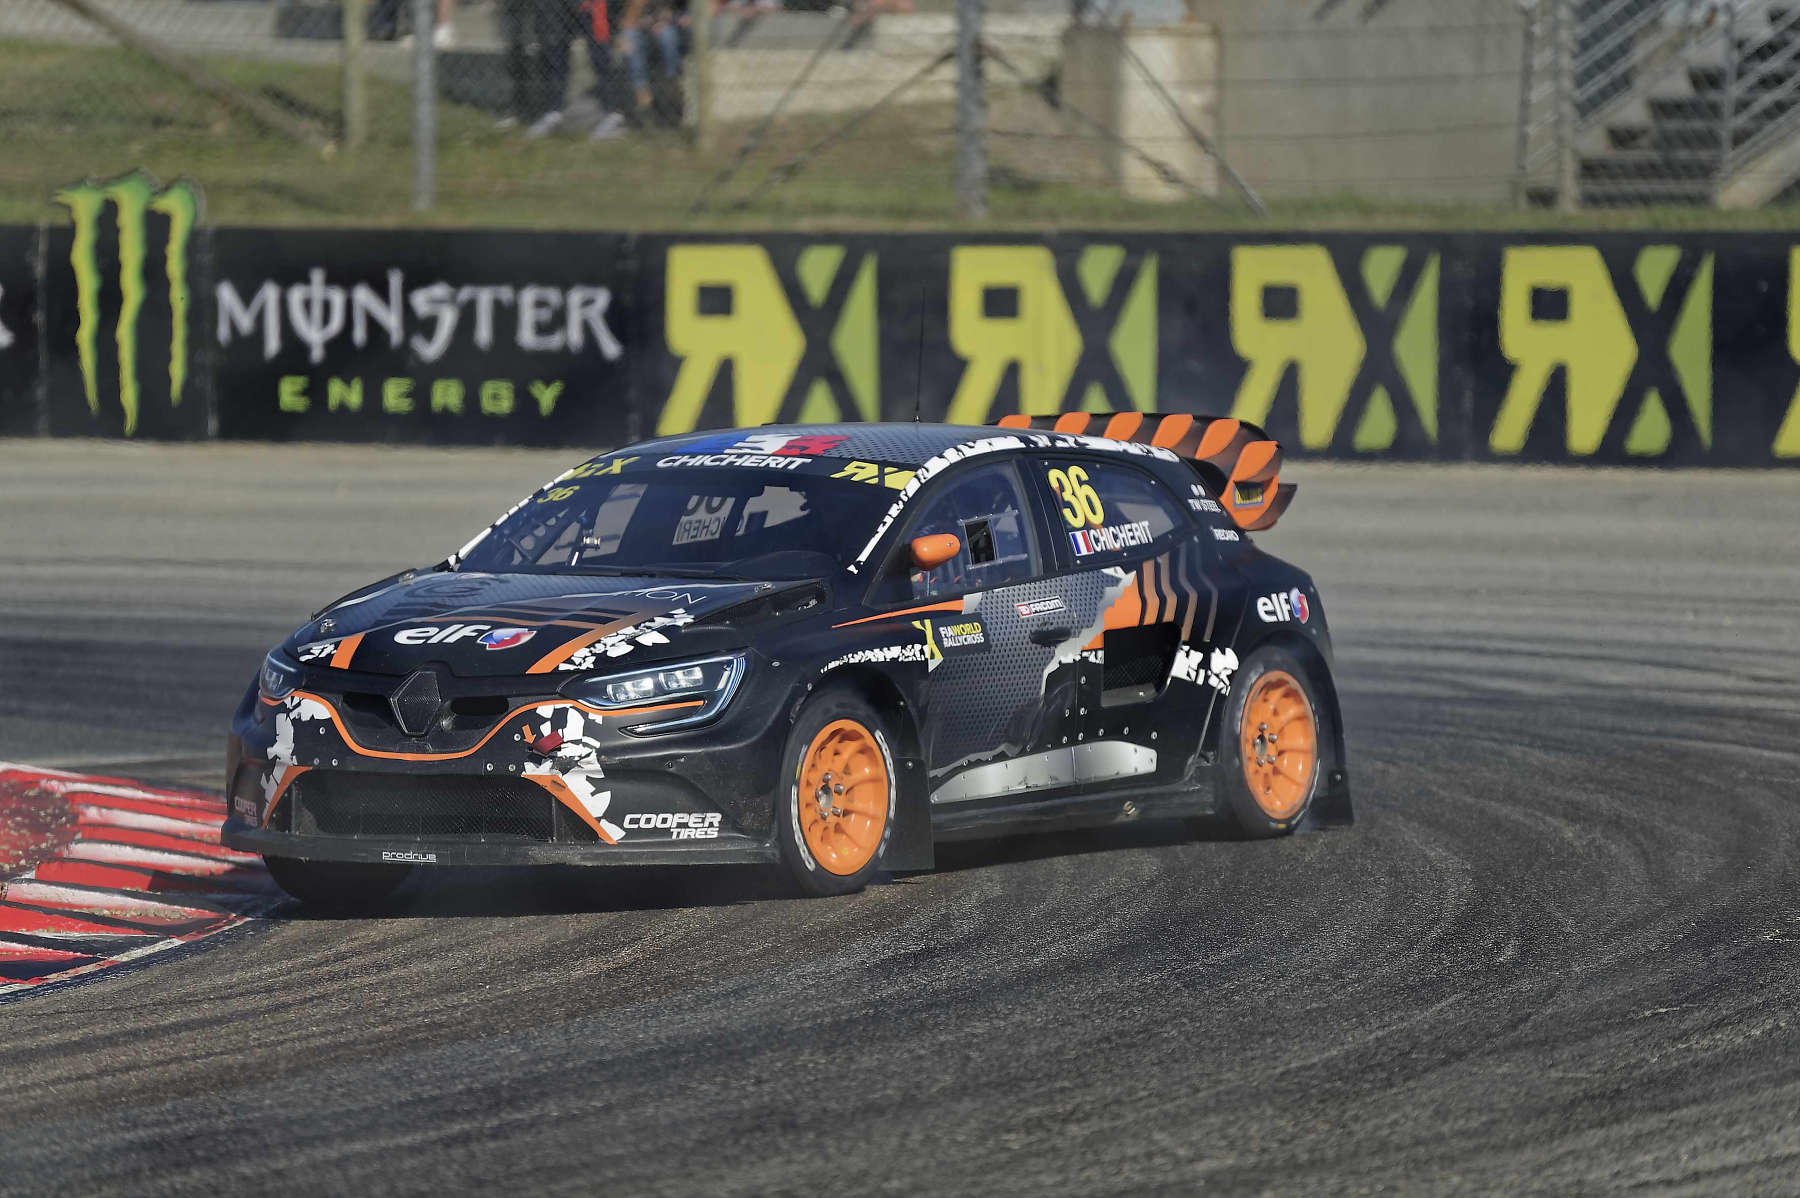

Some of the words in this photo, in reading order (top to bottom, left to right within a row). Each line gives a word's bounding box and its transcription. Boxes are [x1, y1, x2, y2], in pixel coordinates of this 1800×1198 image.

[216, 268, 623, 363] MONSTER
[1230, 244, 1440, 451] RX
[1490, 244, 1715, 455] RX
[278, 375, 564, 416] ENERGY
[656, 454, 812, 471] CHICHERIT
[537, 485, 580, 503] 36
[1048, 465, 1104, 529] 36
[1089, 520, 1153, 552] CHICHERIT
[1031, 600, 1062, 614] FACOM
[1256, 592, 1291, 623] elf
[394, 624, 491, 645] elf
[943, 634, 984, 648] RALLYCROSS
[624, 812, 722, 829] COOPER
[671, 827, 719, 840] TIRES
[382, 850, 437, 863] prodrive
